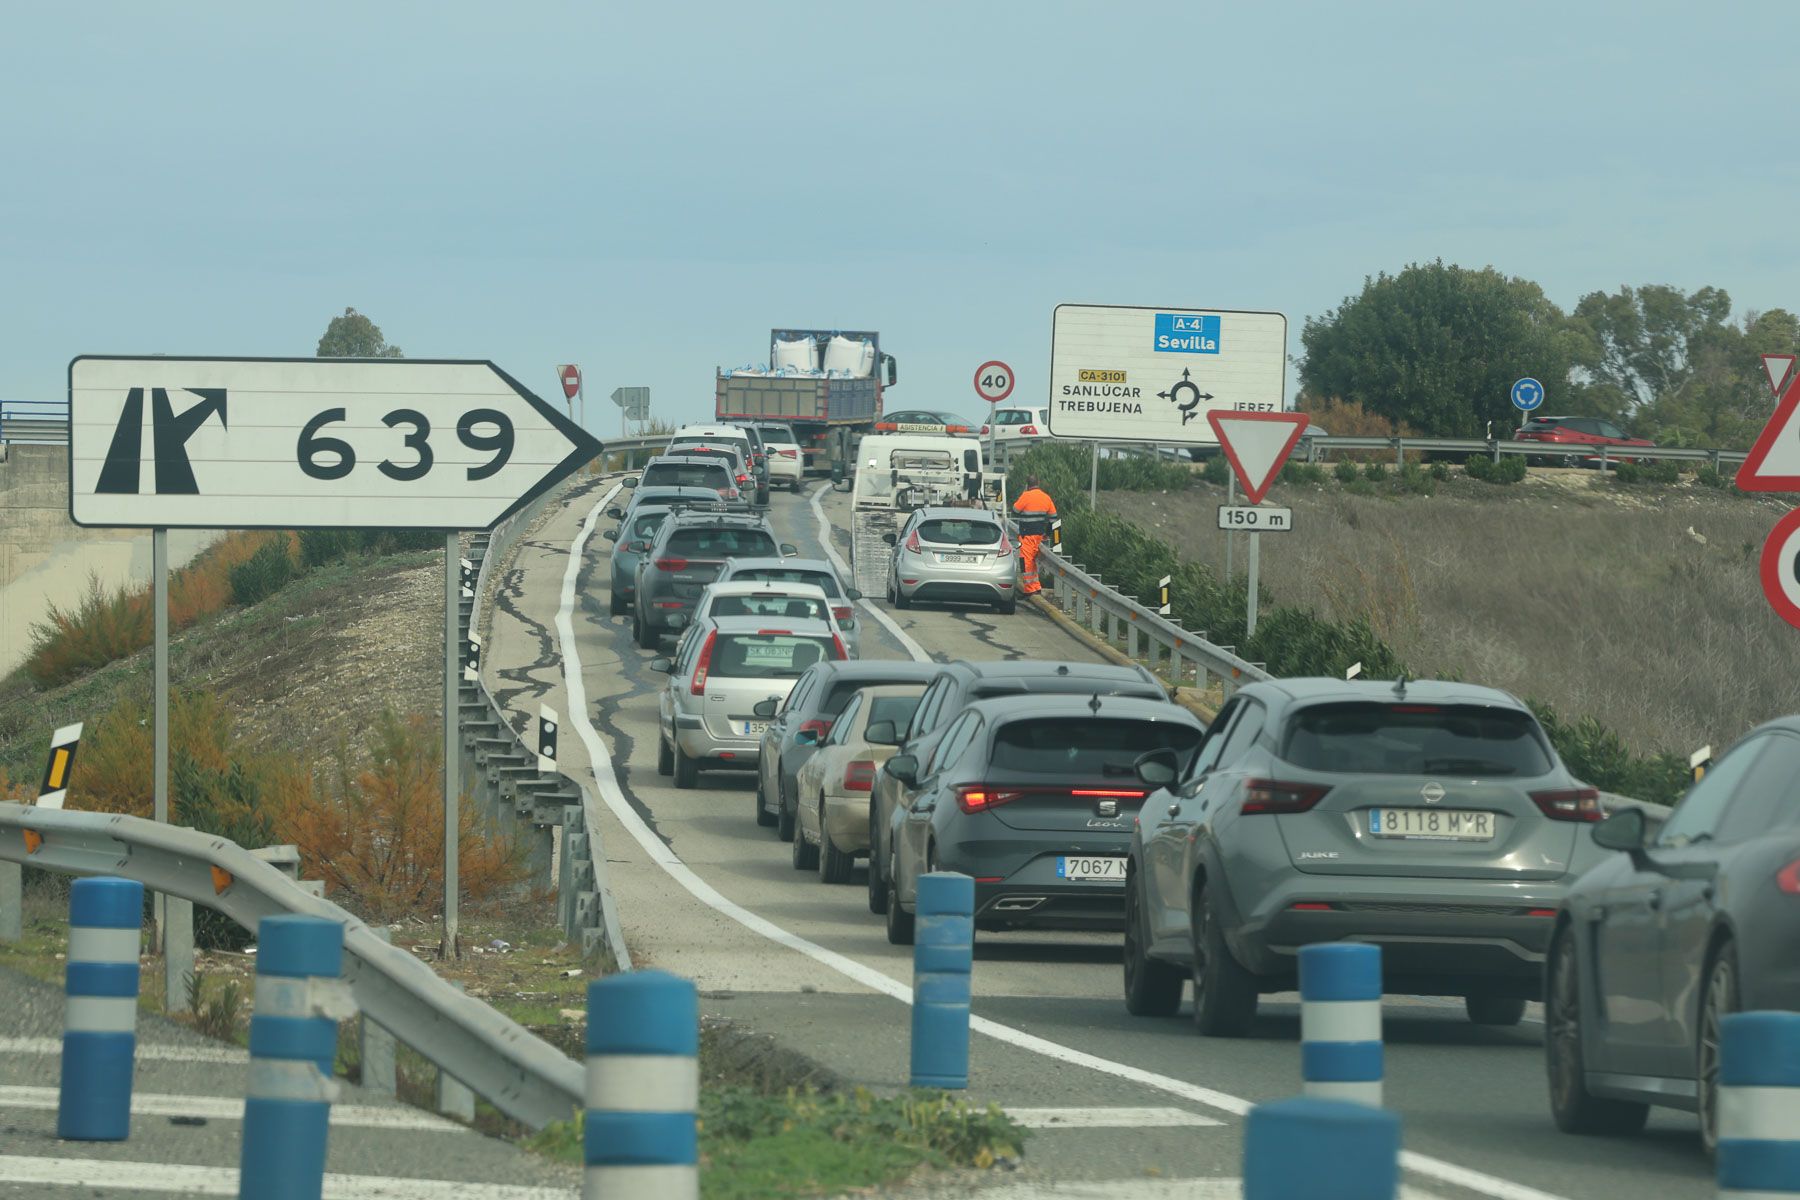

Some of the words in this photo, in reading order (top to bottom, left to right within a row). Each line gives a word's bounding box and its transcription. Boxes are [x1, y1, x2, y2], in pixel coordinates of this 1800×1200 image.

[1176, 318, 1200, 330] A-4
[1158, 335, 1216, 350] Sevilla
[981, 374, 1006, 388] 40
[1080, 371, 1125, 381] CA-3101
[1062, 384, 1141, 398] SANLÚCAR
[1059, 401, 1142, 414] TREBUJENA
[899, 424, 938, 432] ASISTENCIA
[297, 407, 515, 482] 639
[1226, 510, 1258, 525] 150
[1269, 514, 1284, 526] m
[1387, 811, 1440, 832] 8118
[1447, 813, 1488, 834] MYR
[1297, 851, 1340, 861] JUKE
[1070, 860, 1113, 875] 7067
